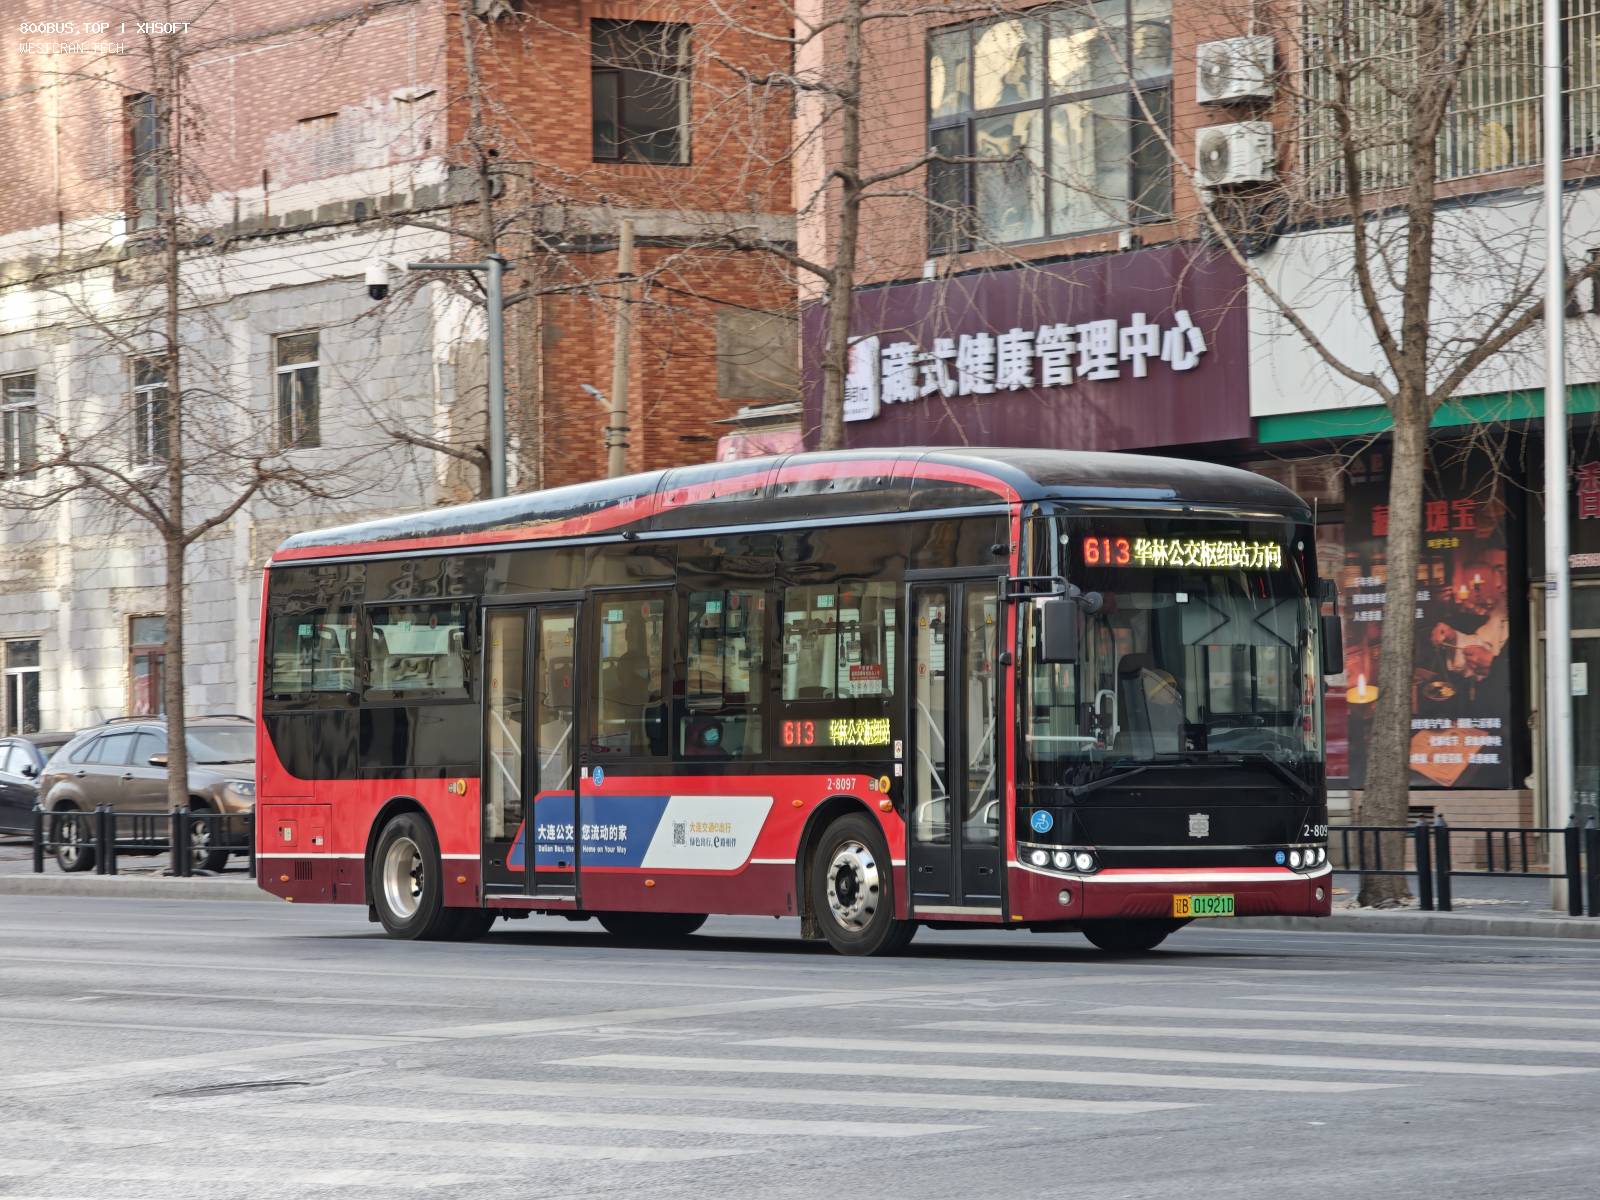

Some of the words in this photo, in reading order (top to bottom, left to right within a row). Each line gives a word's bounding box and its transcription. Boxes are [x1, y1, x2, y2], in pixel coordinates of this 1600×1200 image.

[880, 310, 1208, 404] 藏式健康管理中心
[1083, 536, 1130, 565] 613
[1134, 537, 1282, 568] 华林公交枢纽站方向
[783, 720, 815, 745] 613
[827, 778, 856, 790] 2-8097
[537, 823, 574, 841] 大连公交
[582, 824, 627, 841] 您流动的家
[1304, 824, 1328, 837] 2-809
[617, 846, 627, 855] Way
